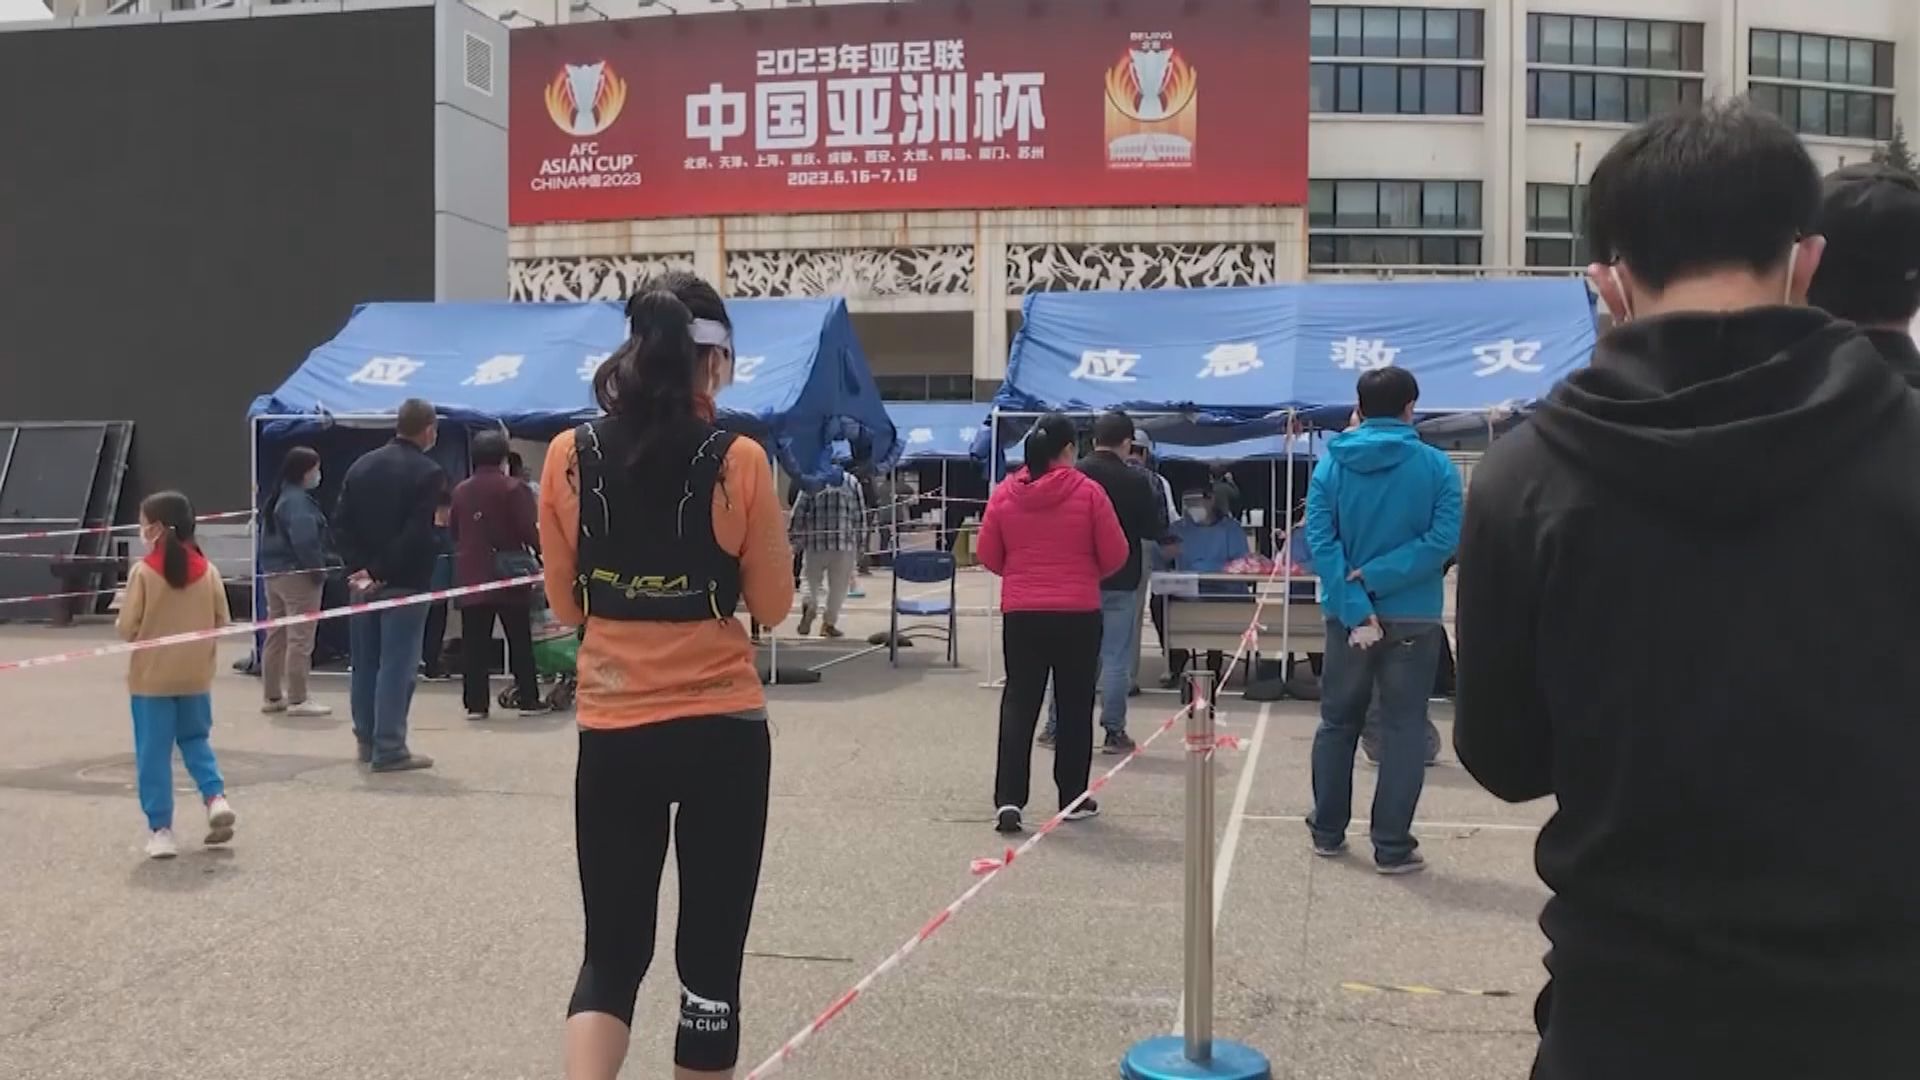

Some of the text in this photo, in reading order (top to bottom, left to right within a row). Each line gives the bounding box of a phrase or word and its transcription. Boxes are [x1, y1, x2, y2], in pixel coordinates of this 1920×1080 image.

[756, 39, 965, 75] 2023年亚足联
[686, 72, 1045, 151] 中国亚洲杯
[569, 142, 599, 157] AFC
[539, 157, 593, 175] ASIAN
[696, 1018, 729, 1032] Club
